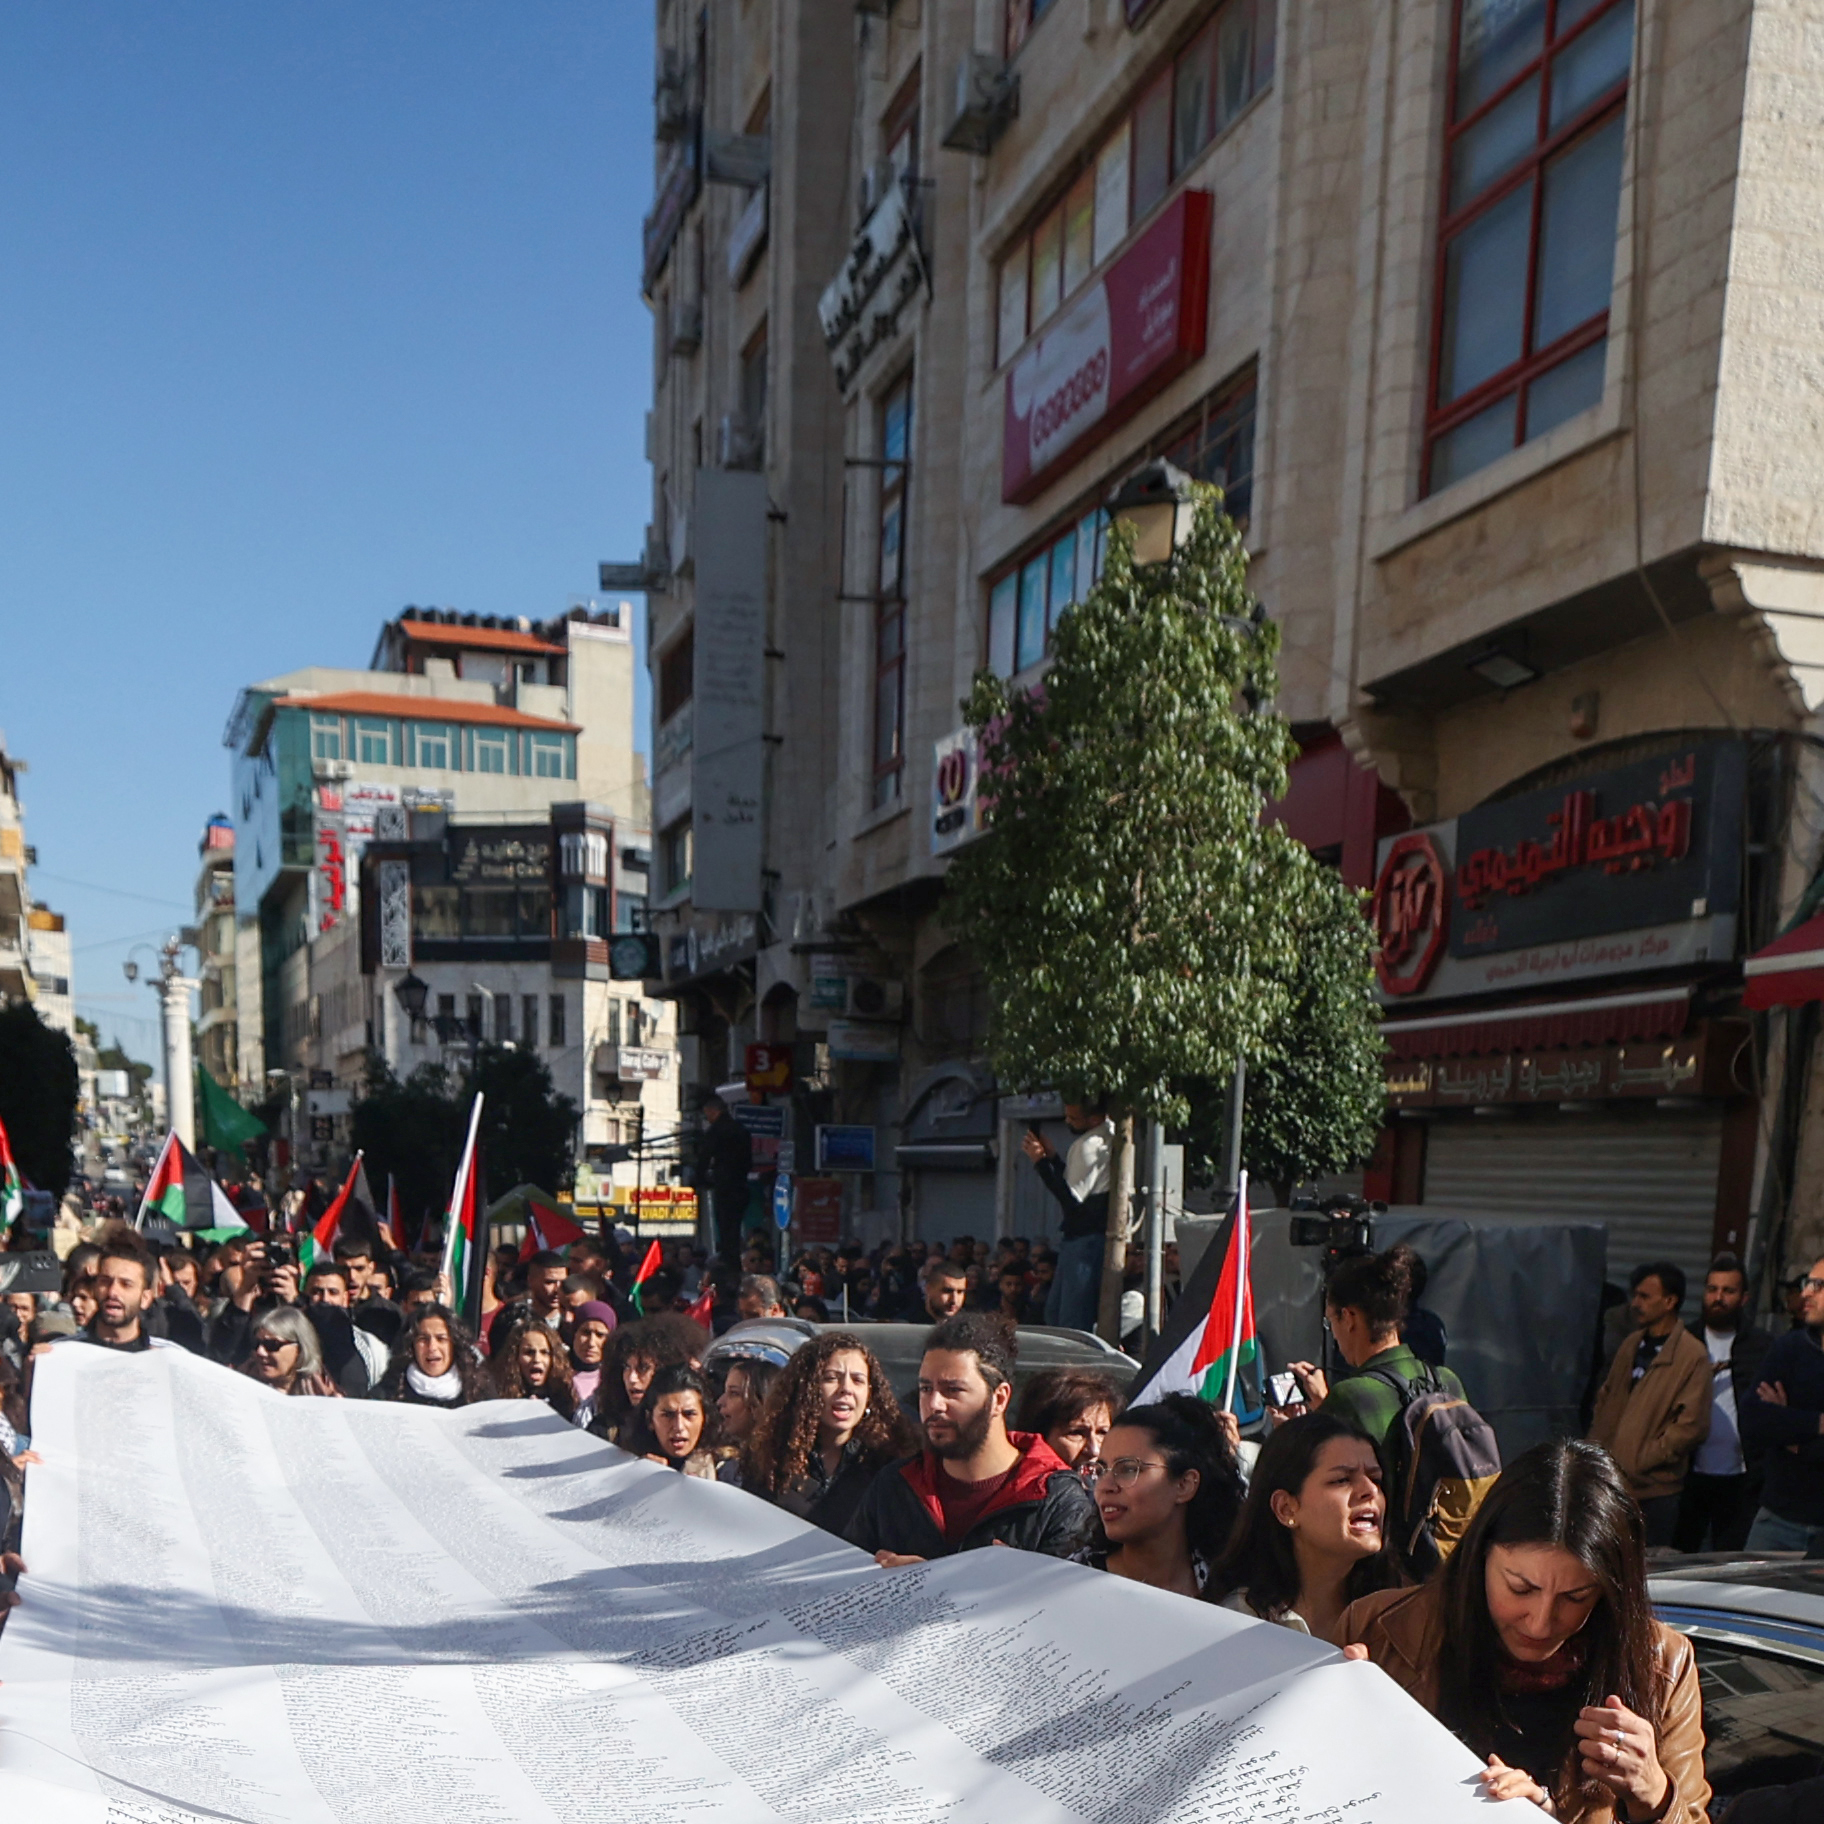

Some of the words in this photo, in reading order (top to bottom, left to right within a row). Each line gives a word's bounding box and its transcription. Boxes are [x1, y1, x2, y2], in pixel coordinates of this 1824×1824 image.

[1458, 790, 1595, 910] التميمي
[1588, 798, 1692, 874] وجيه
[755, 1050, 771, 1072] 3
[1612, 1046, 1697, 1093] مركز
